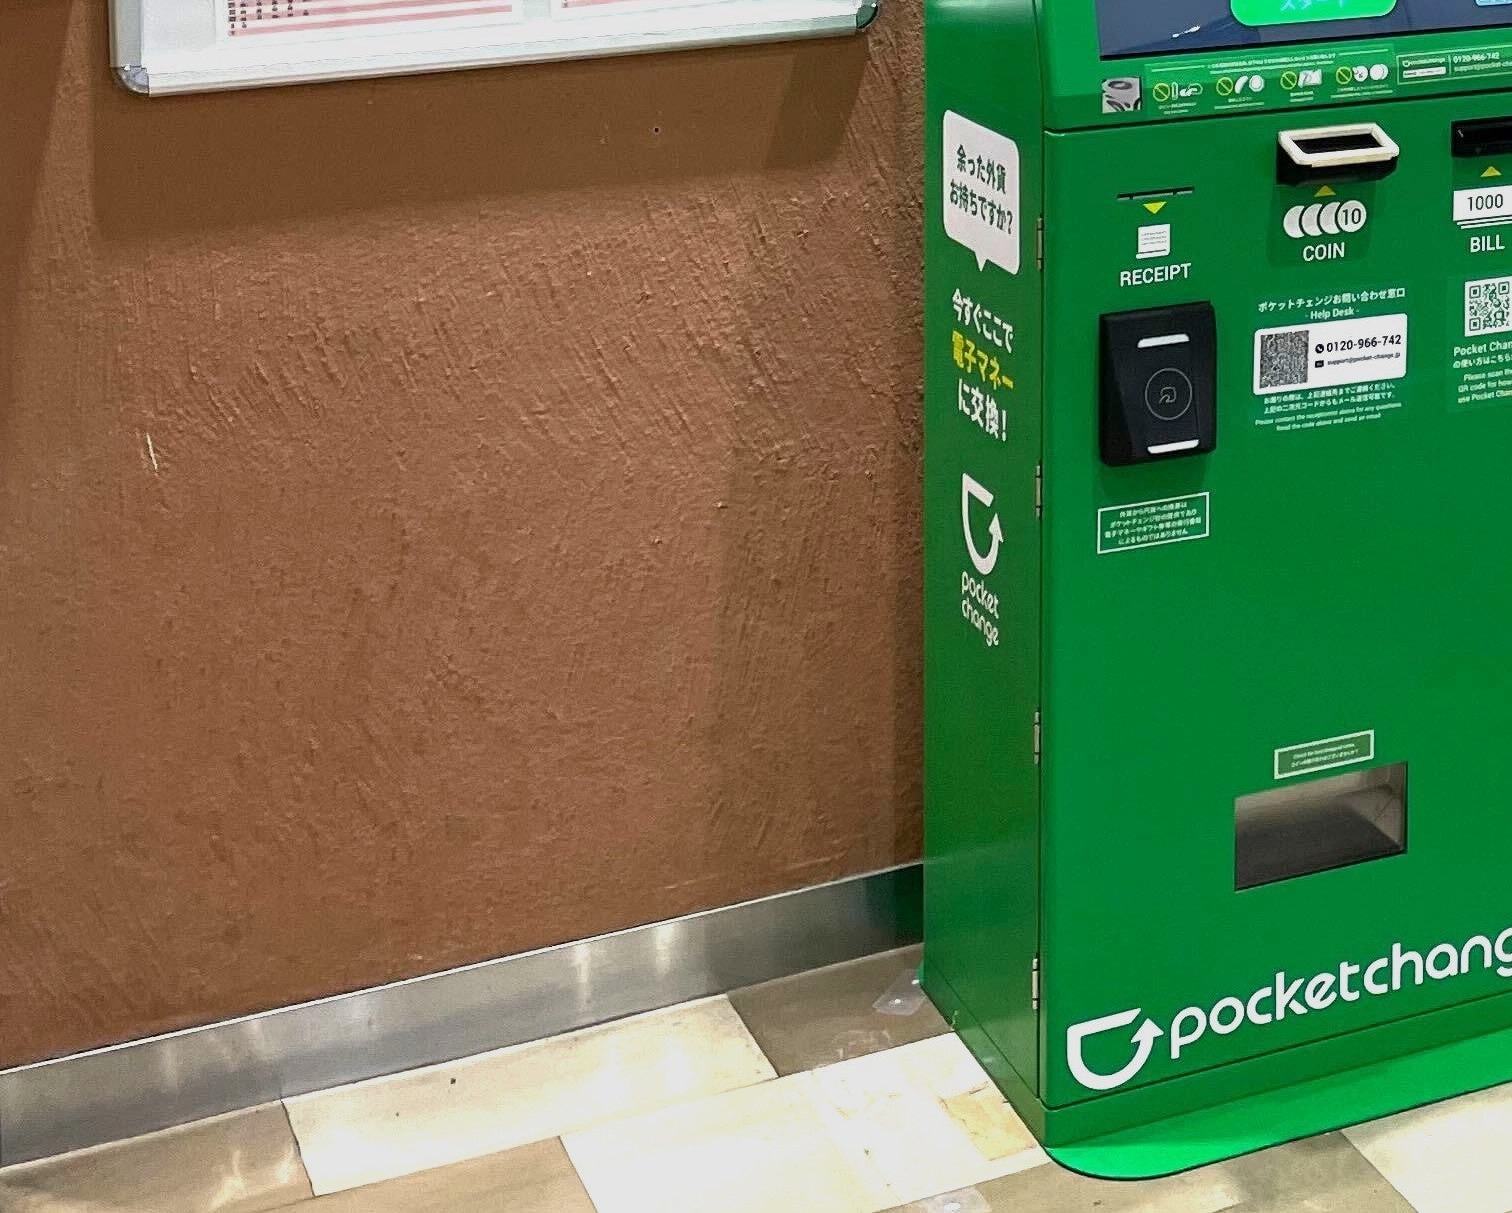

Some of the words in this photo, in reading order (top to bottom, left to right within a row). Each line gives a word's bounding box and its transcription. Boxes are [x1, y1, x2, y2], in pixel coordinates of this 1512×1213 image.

[956, 143, 1007, 195] 余った外貨
[1466, 193, 1505, 212] 1000
[1342, 207, 1362, 227] 10
[1302, 241, 1346, 262] COIN
[1469, 234, 1506, 253] BILL
[1119, 262, 1192, 287] RECEIPT
[1258, 288, 1406, 313] ポケットチェンジお問い合わせ窓口
[952, 288, 1014, 354] 今すぐここで
[1310, 309, 1331, 320] Help
[1332, 307, 1355, 317] Desk
[1326, 334, 1402, 353] 0120-966-742
[1453, 343, 1488, 357] Pocket
[952, 329, 1014, 390] 電子マネー
[961, 570, 1000, 620] pocket
[961, 596, 999, 647] change
